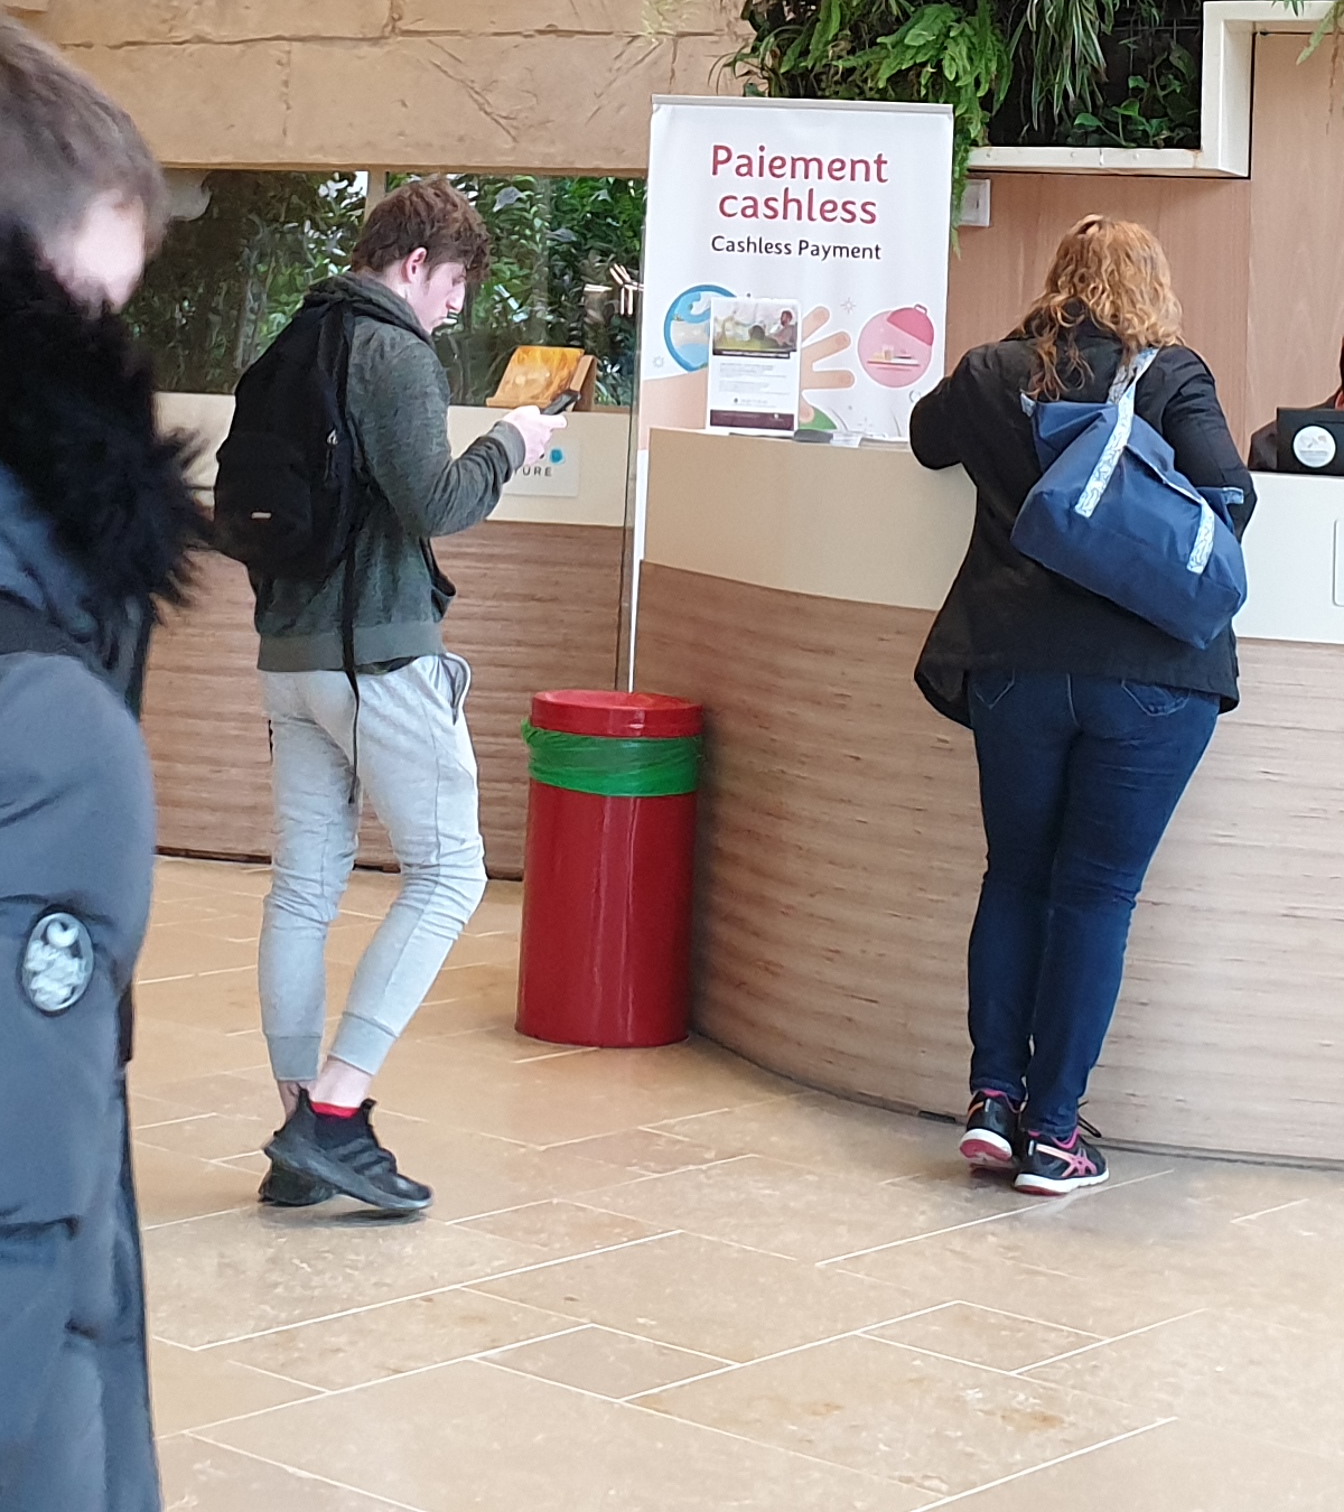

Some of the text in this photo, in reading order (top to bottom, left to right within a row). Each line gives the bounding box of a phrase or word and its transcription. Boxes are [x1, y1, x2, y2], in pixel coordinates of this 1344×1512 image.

[711, 144, 889, 183] Paiement
[718, 187, 878, 224] cashless
[711, 235, 882, 261] Cashless Payment
